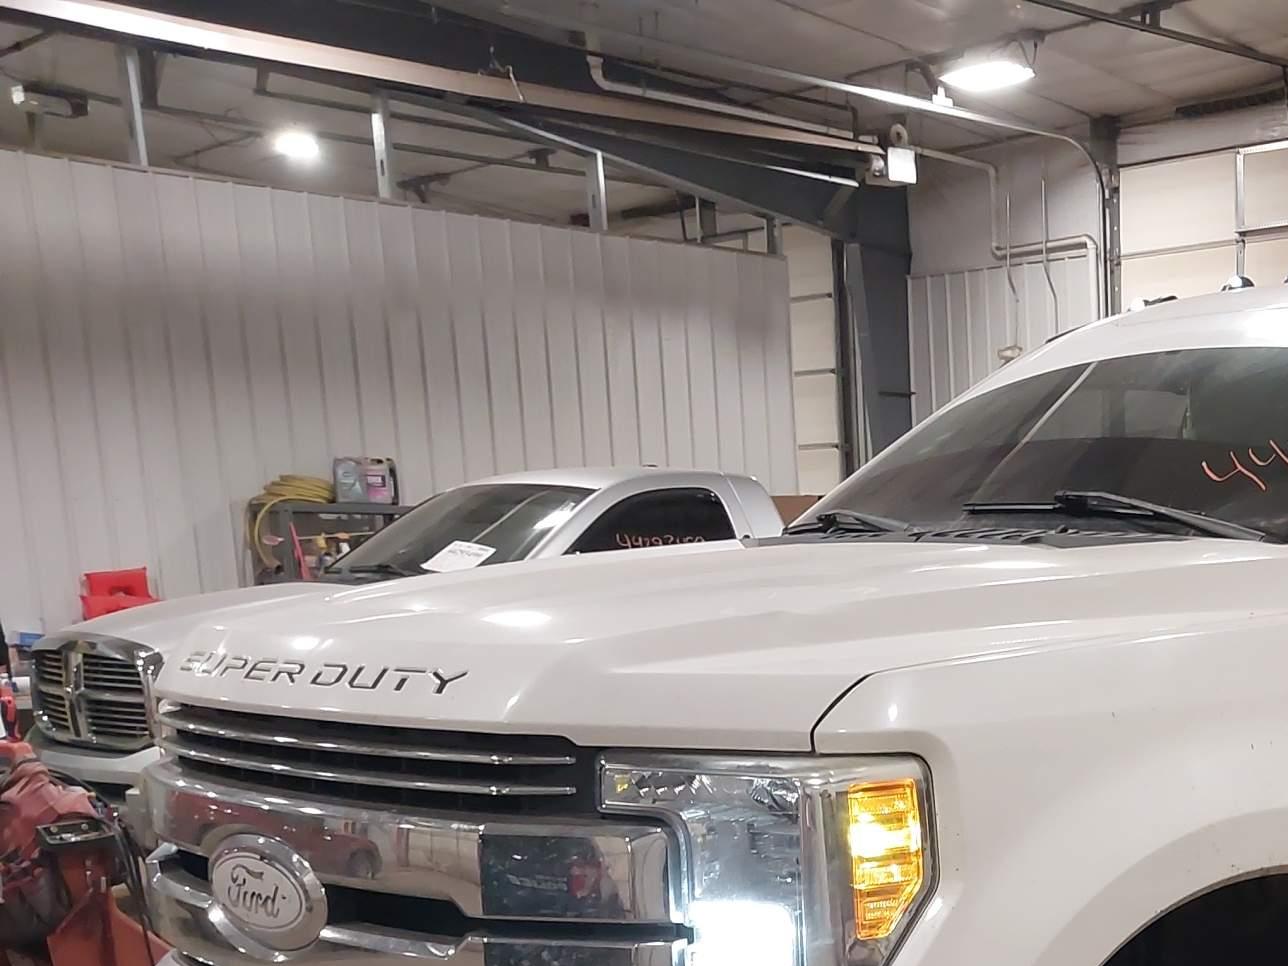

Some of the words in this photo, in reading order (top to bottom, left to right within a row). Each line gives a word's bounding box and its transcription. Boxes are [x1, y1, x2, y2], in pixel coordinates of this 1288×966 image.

[179, 651, 305, 685] SUPER
[309, 664, 470, 695] DUTY
[228, 863, 280, 919] Ford
